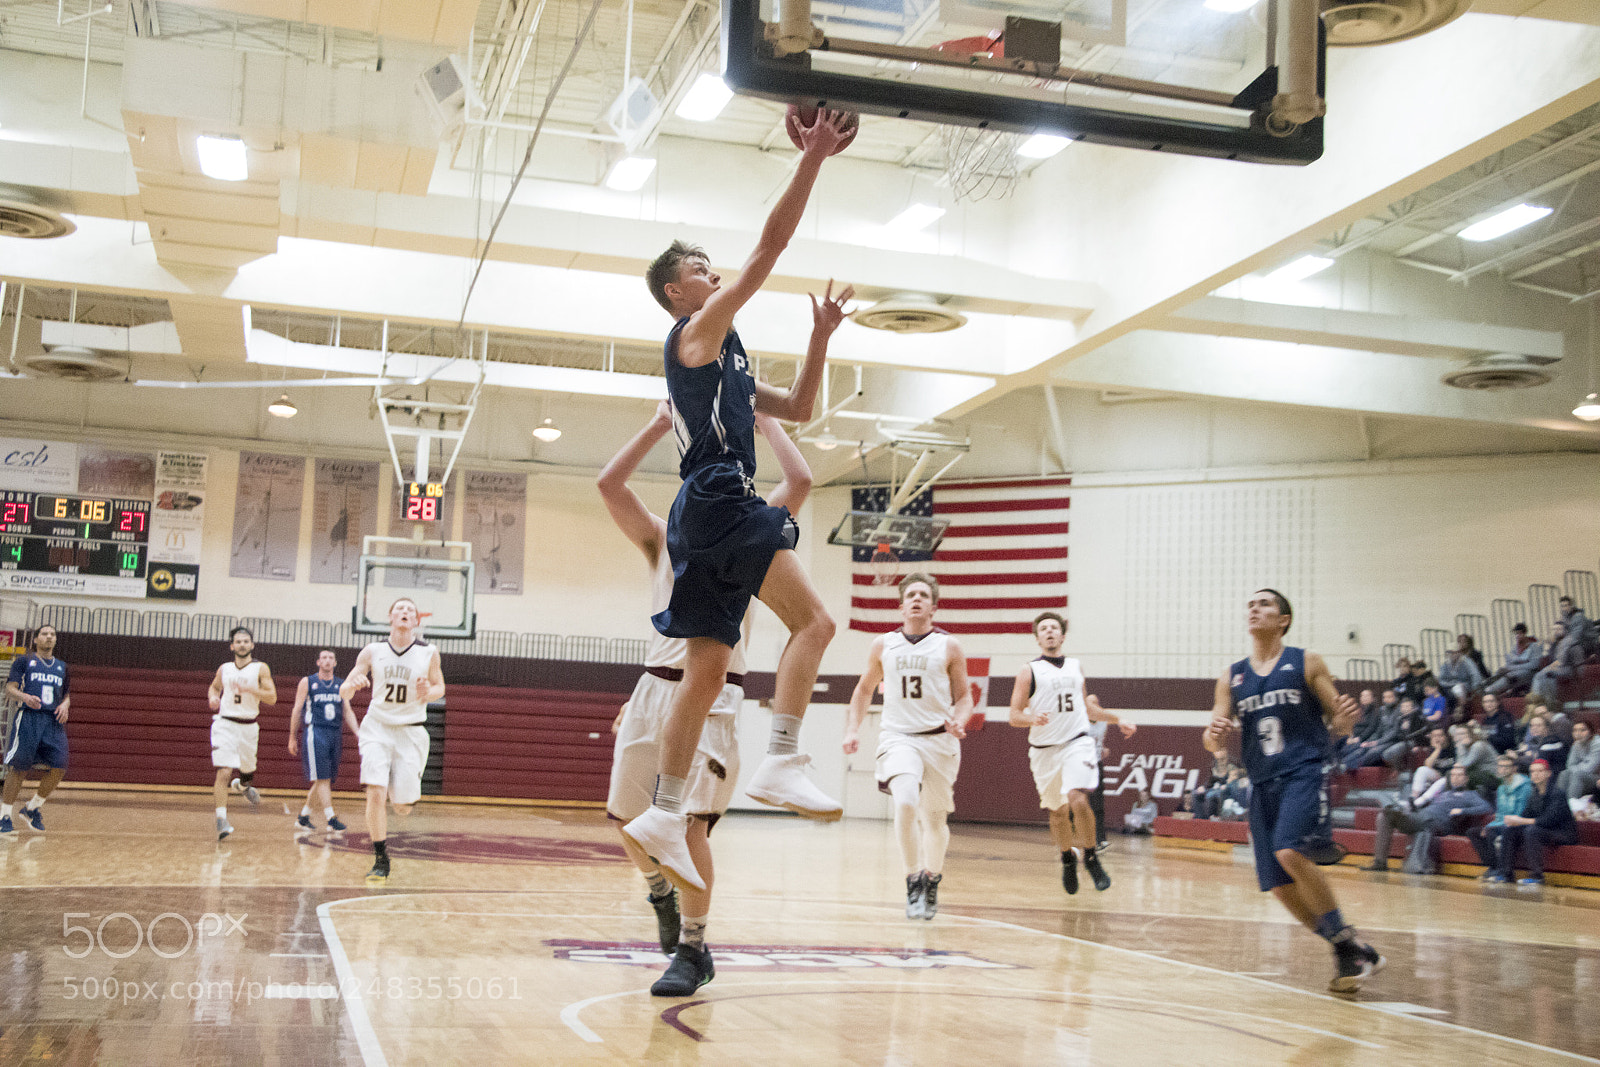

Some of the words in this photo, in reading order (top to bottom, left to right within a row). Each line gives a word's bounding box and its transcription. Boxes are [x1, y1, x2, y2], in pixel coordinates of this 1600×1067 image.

[4, 445, 48, 467] csb
[4, 502, 29, 523] 27
[115, 500, 150, 512] VISITOR
[407, 497, 436, 521] 28
[7, 524, 32, 534] BONUS
[120, 511, 145, 532] 27
[52, 527, 76, 537] PERIOD
[111, 531, 136, 541] BONUS
[11, 546, 21, 561] 4
[46, 539, 74, 549] PLAYER
[79, 541, 101, 551] FOULS
[117, 543, 140, 554] FOULS
[122, 553, 138, 569] 10
[11, 575, 86, 587] GINGERICH
[895, 654, 929, 672] FAITH
[30, 672, 63, 687] PILOTS
[384, 664, 413, 681] FAITH
[41, 684, 54, 705] 5
[384, 683, 408, 704] 20
[902, 675, 922, 699] 13
[1057, 693, 1074, 713] 15
[1236, 688, 1302, 717] PILOTS
[1255, 715, 1286, 756] 3
[1120, 753, 1184, 770] FAITH
